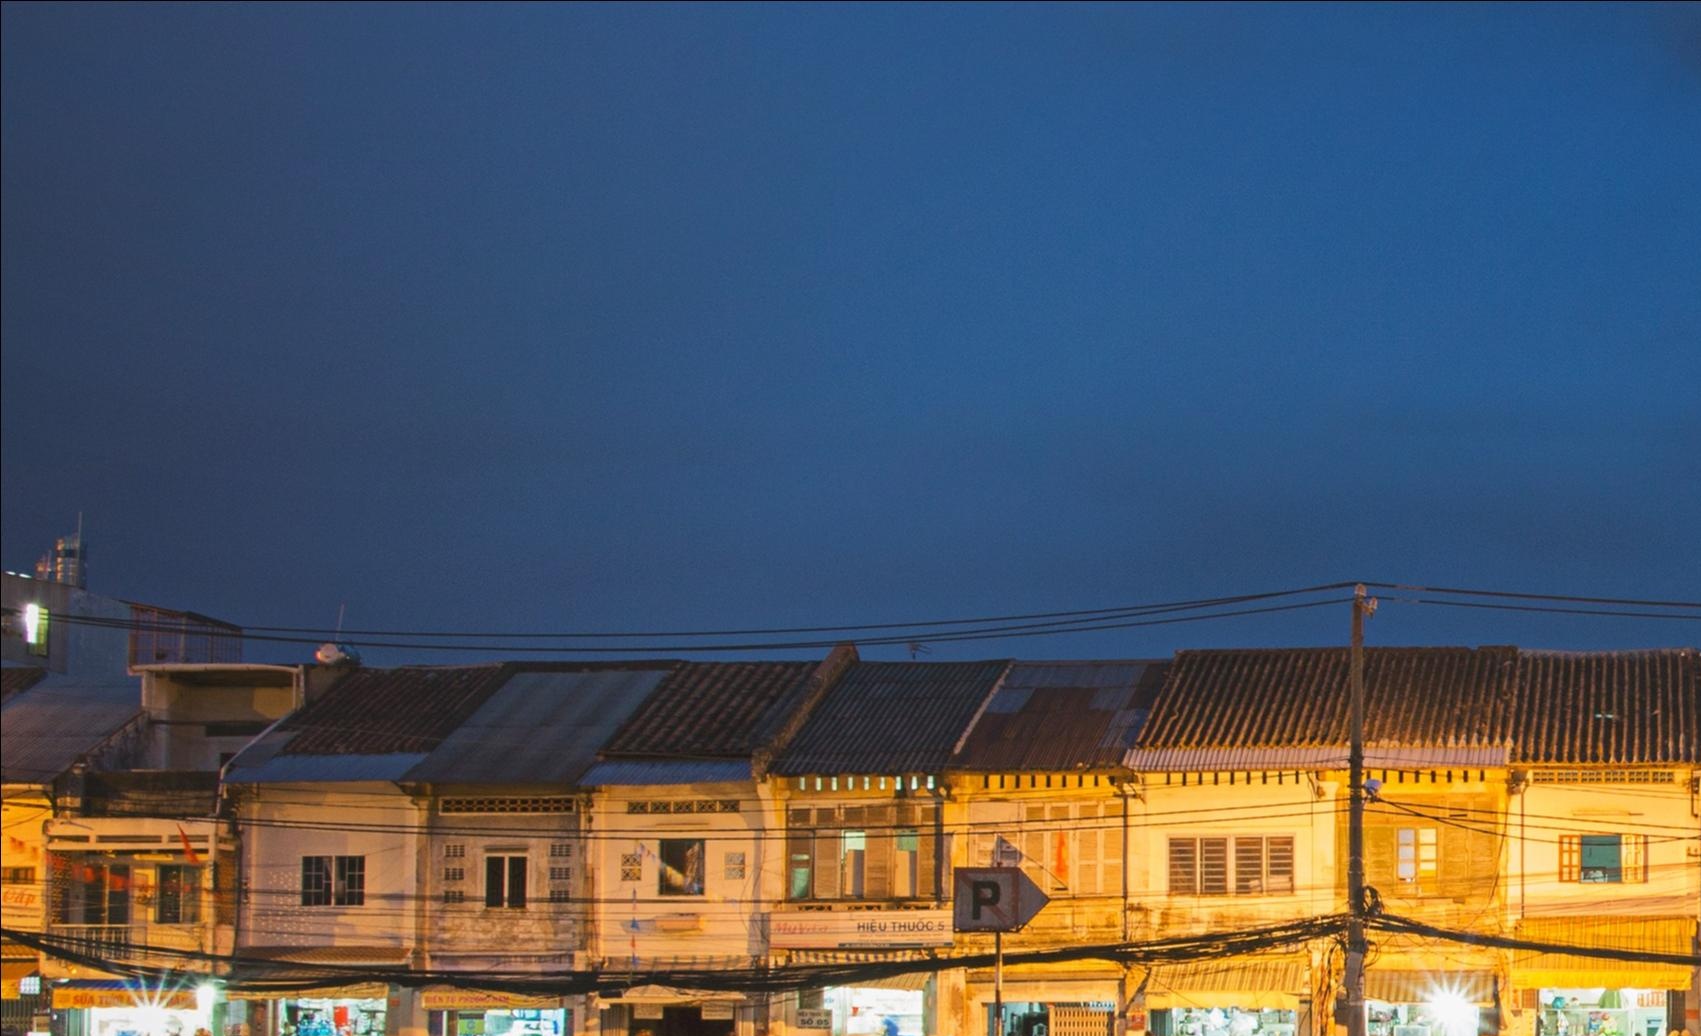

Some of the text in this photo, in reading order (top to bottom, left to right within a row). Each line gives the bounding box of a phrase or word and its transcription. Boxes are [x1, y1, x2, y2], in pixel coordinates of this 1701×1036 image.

[972, 881, 1000, 920] P
[857, 917, 945, 933] HIỆU THUỐC 5
